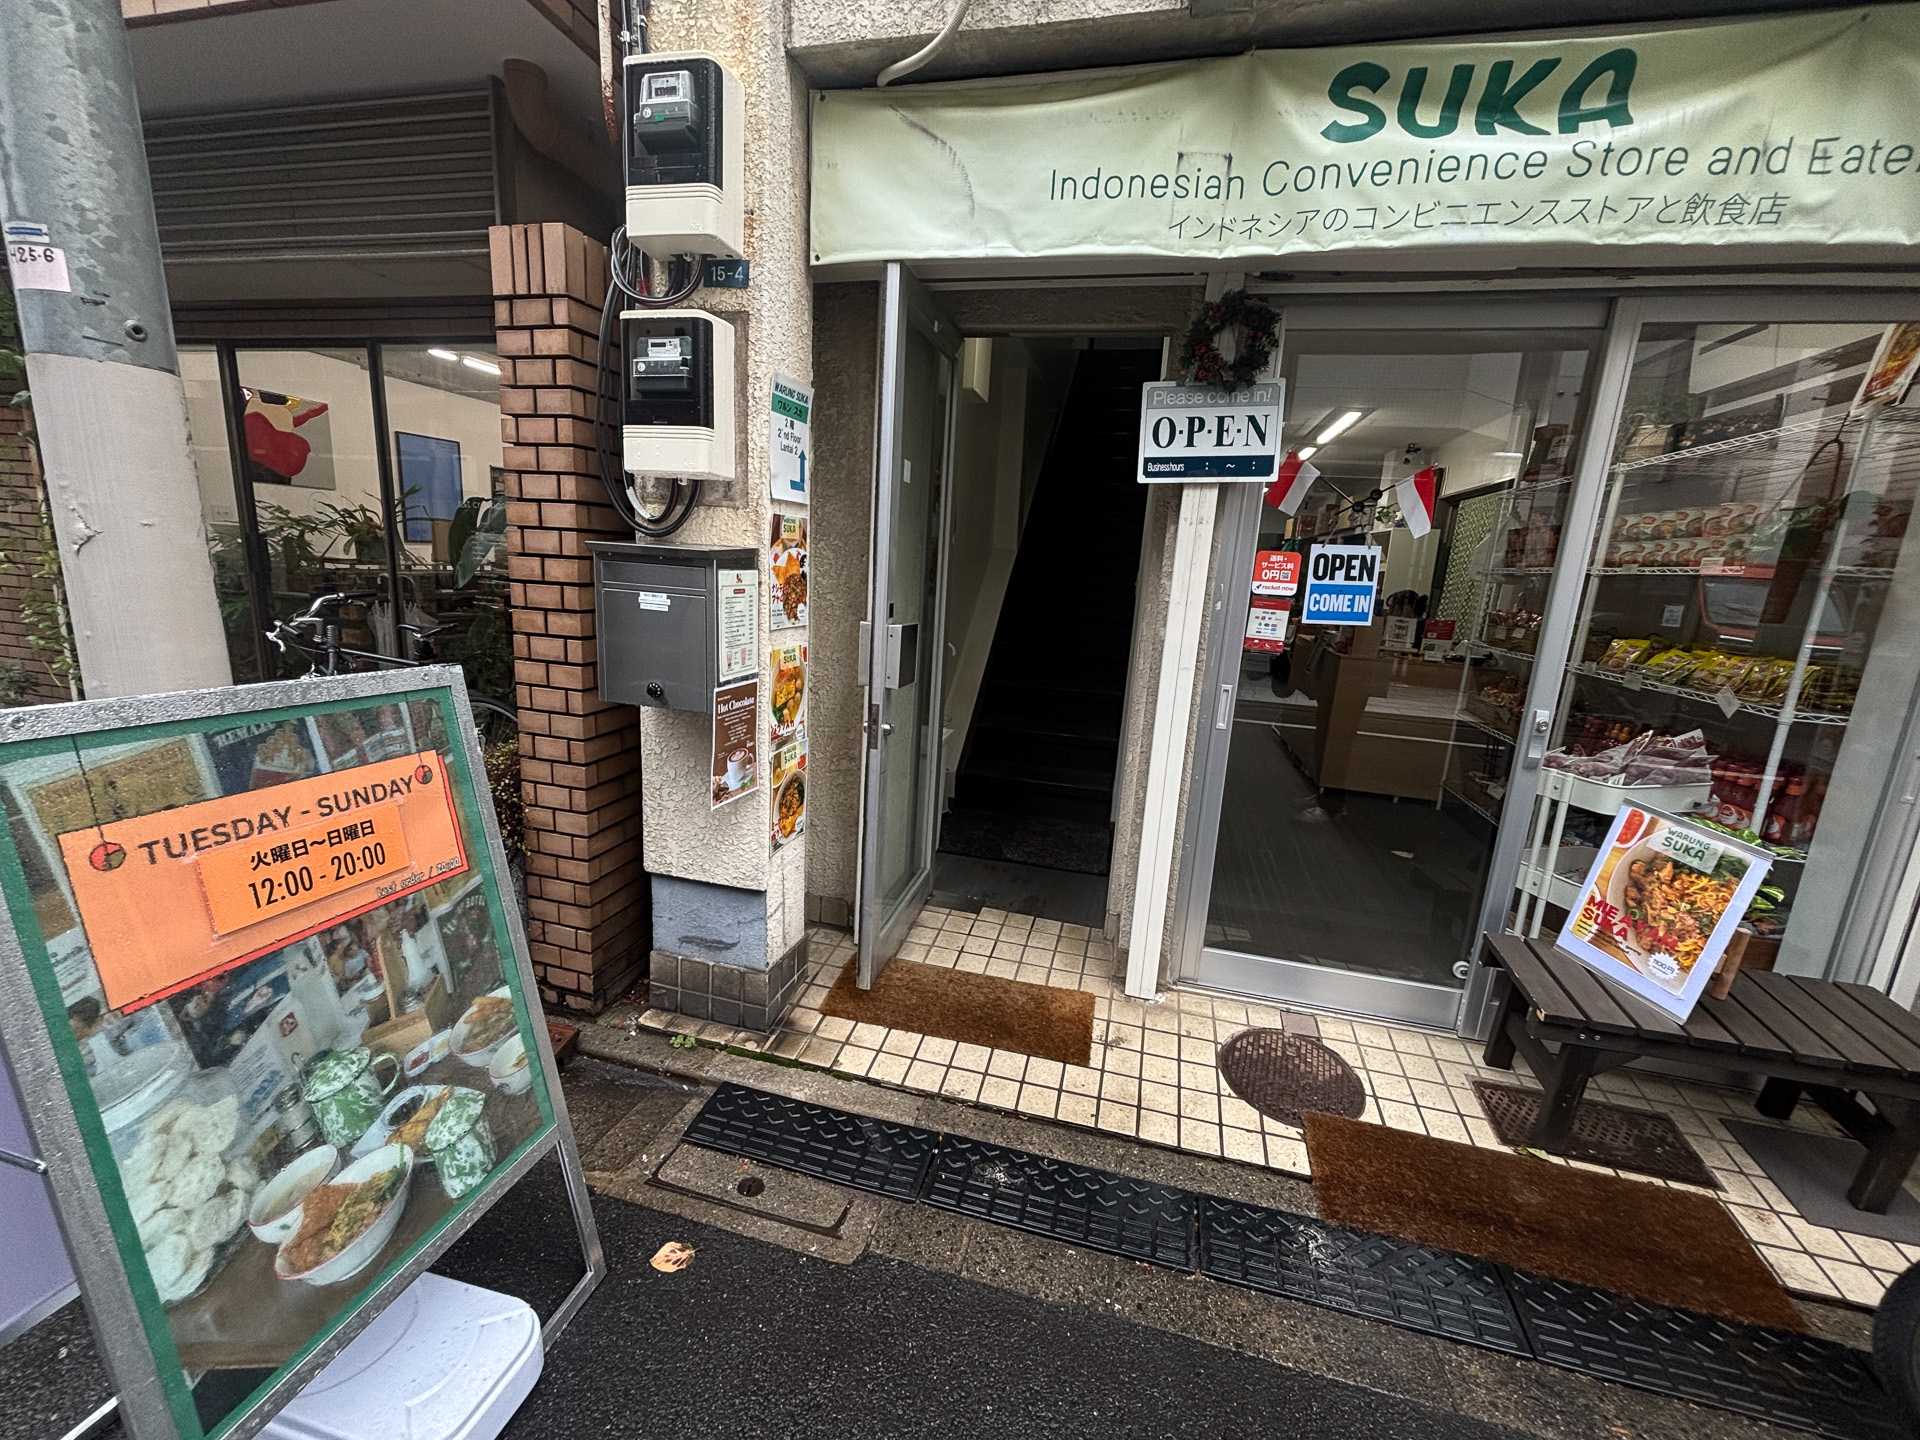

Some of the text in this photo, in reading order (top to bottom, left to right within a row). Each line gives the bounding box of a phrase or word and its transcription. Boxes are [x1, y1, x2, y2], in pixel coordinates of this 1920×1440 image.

[1320, 48, 1637, 143] SUKA
[1051, 167, 1244, 200] Indonesian
[1263, 149, 1547, 196] Convenience
[1566, 140, 1689, 178] Store
[1707, 136, 1794, 176] and
[1169, 192, 1791, 241] インドネシアのコンビニエンスストアと飲食店
[711, 265, 743, 282] 15-4
[774, 382, 809, 405] WARUNG SUKA
[1153, 388, 1272, 406] Please come in!
[780, 441, 798, 456] Lantai 2
[790, 432, 802, 444] Floor
[783, 524, 796, 534] SUKA
[1262, 570, 1280, 580] 0円
[1312, 553, 1376, 582] OPEN
[1309, 593, 1370, 612] COME IN
[784, 654, 796, 664] SUKA
[784, 752, 798, 764] SUKA
[138, 806, 292, 866] TUESDAY
[316, 774, 414, 818] SUNDAY
[1662, 836, 1706, 862] SUKA
[1668, 827, 1711, 850] WARUNG
[248, 866, 314, 909] 12:00
[330, 842, 386, 882] 20:00
[400, 871, 424, 886] order
[1586, 895, 1619, 916] MIE
[1582, 908, 1628, 942] SUKA
